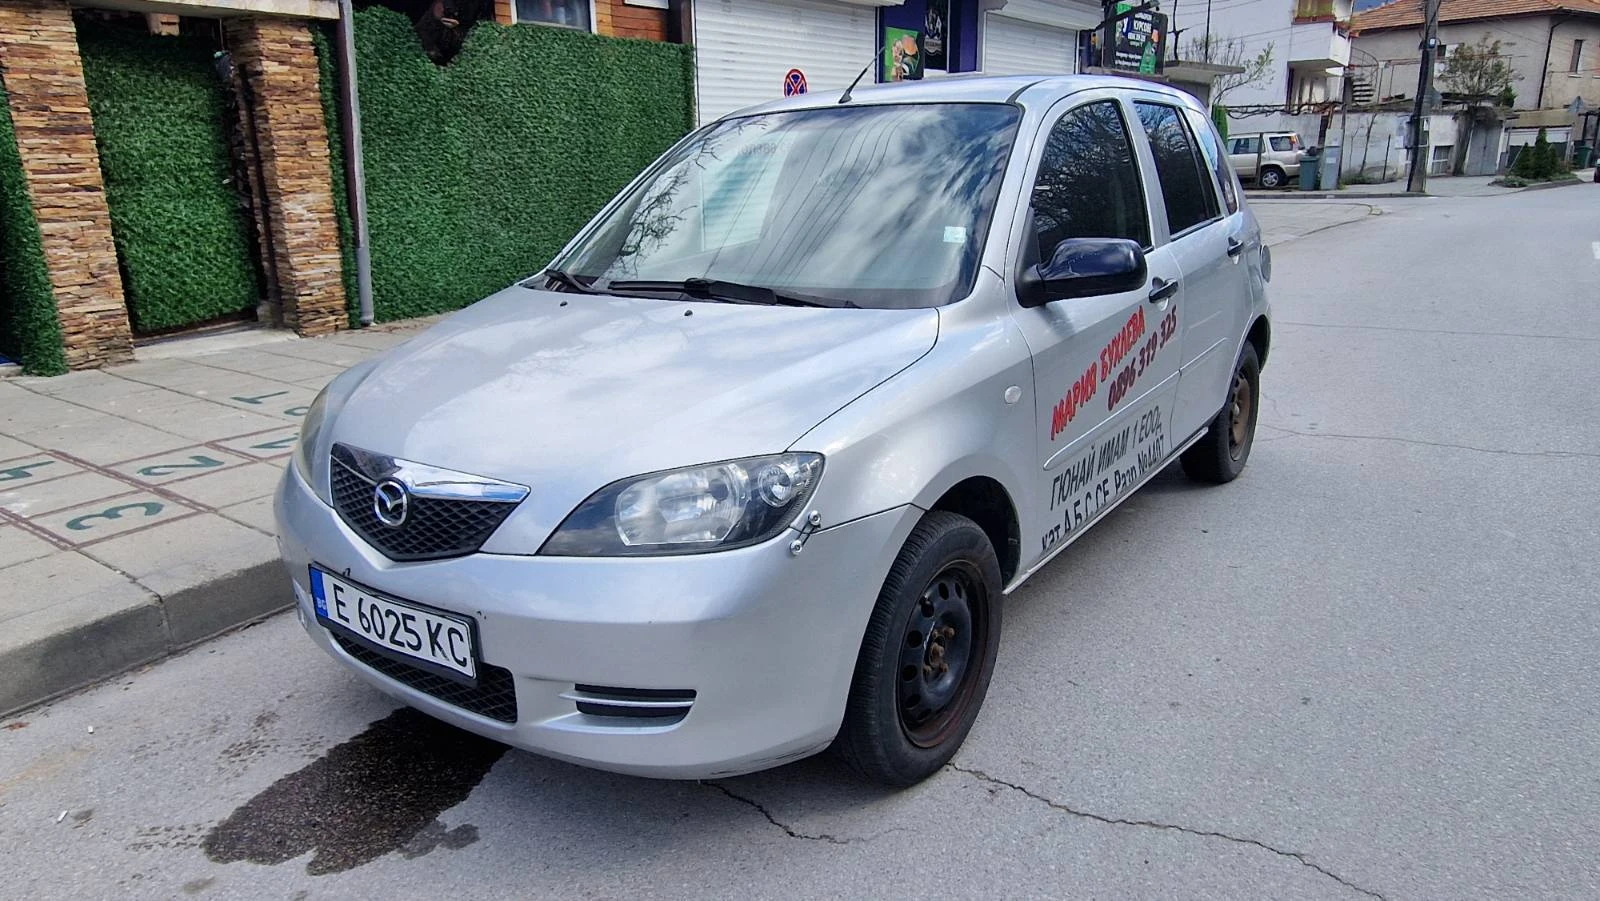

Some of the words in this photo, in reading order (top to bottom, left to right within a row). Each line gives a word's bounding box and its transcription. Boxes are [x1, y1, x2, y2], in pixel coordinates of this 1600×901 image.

[1051, 362, 1097, 441] МАРИЯ
[1100, 305, 1146, 383] БУХЛЕВА
[1107, 357, 1136, 412] 0896
[1138, 331, 1158, 377] 319
[1160, 304, 1177, 349] 325
[136, 456, 225, 477] 2
[1050, 443, 1096, 511] ГЮНАЙ
[1097, 426, 1130, 476] ИМАМ
[1139, 405, 1162, 443] ЕООД
[65, 502, 165, 531] 3
[333, 583, 350, 624] E
[357, 597, 422, 652] 6025
[426, 619, 468, 668] KC
